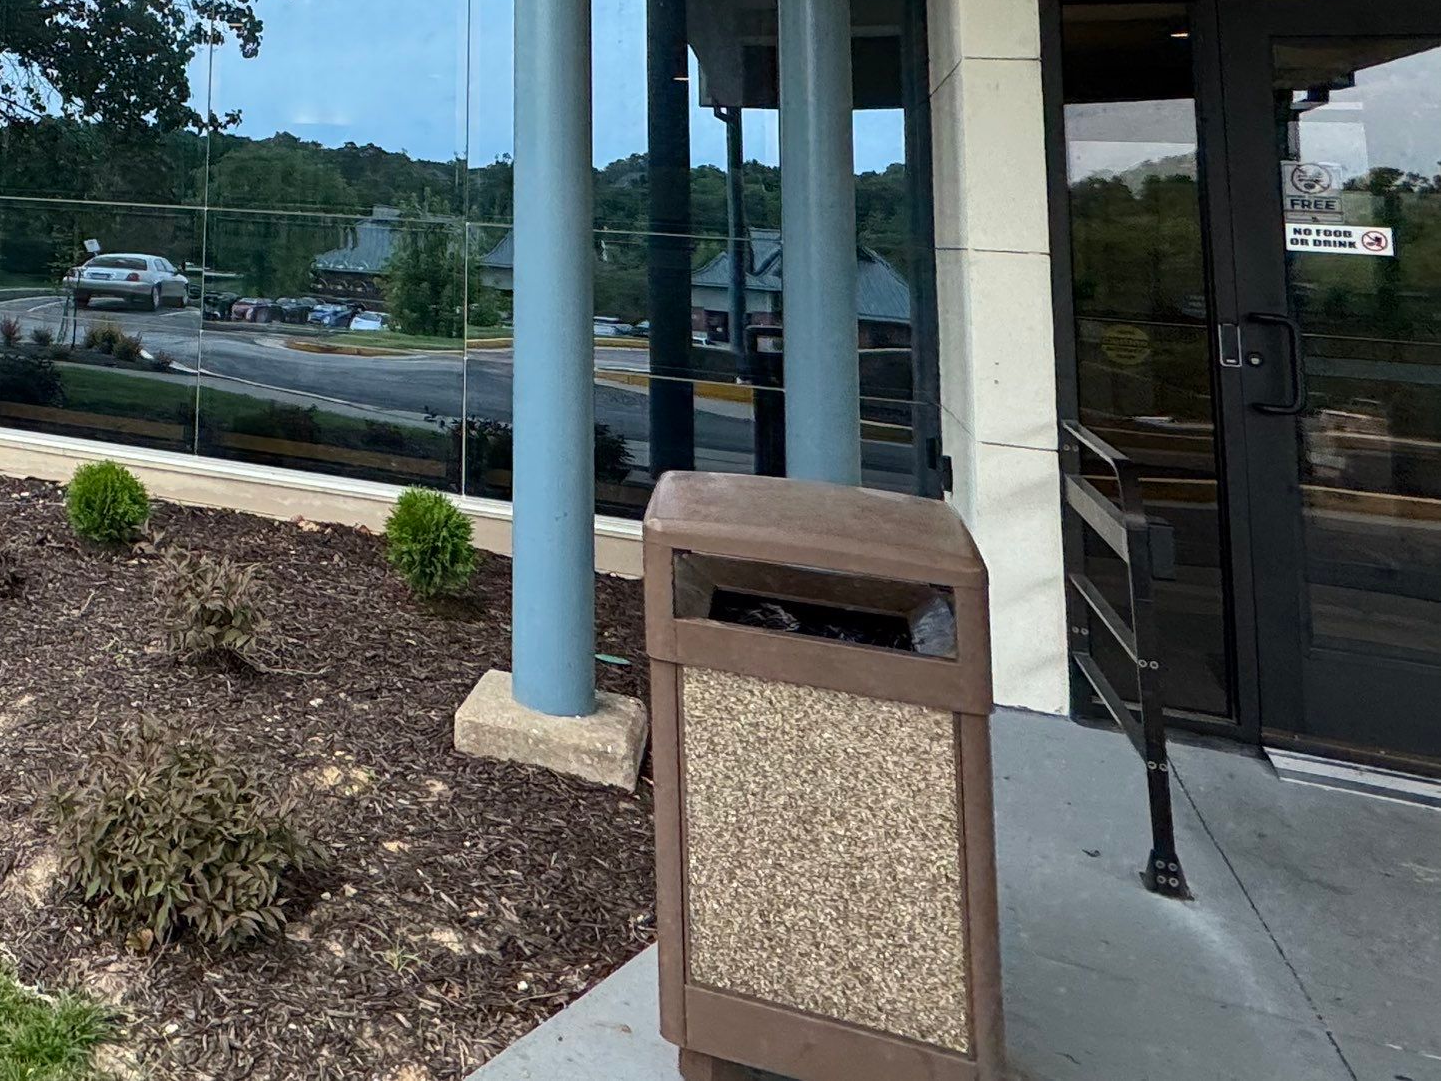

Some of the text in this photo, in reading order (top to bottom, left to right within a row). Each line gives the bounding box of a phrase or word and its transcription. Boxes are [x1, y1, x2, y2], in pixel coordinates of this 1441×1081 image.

[1290, 199, 1337, 210] FREE
[1293, 227, 1352, 238] NO FOOD
[1290, 238, 1356, 248] OR DRINK
